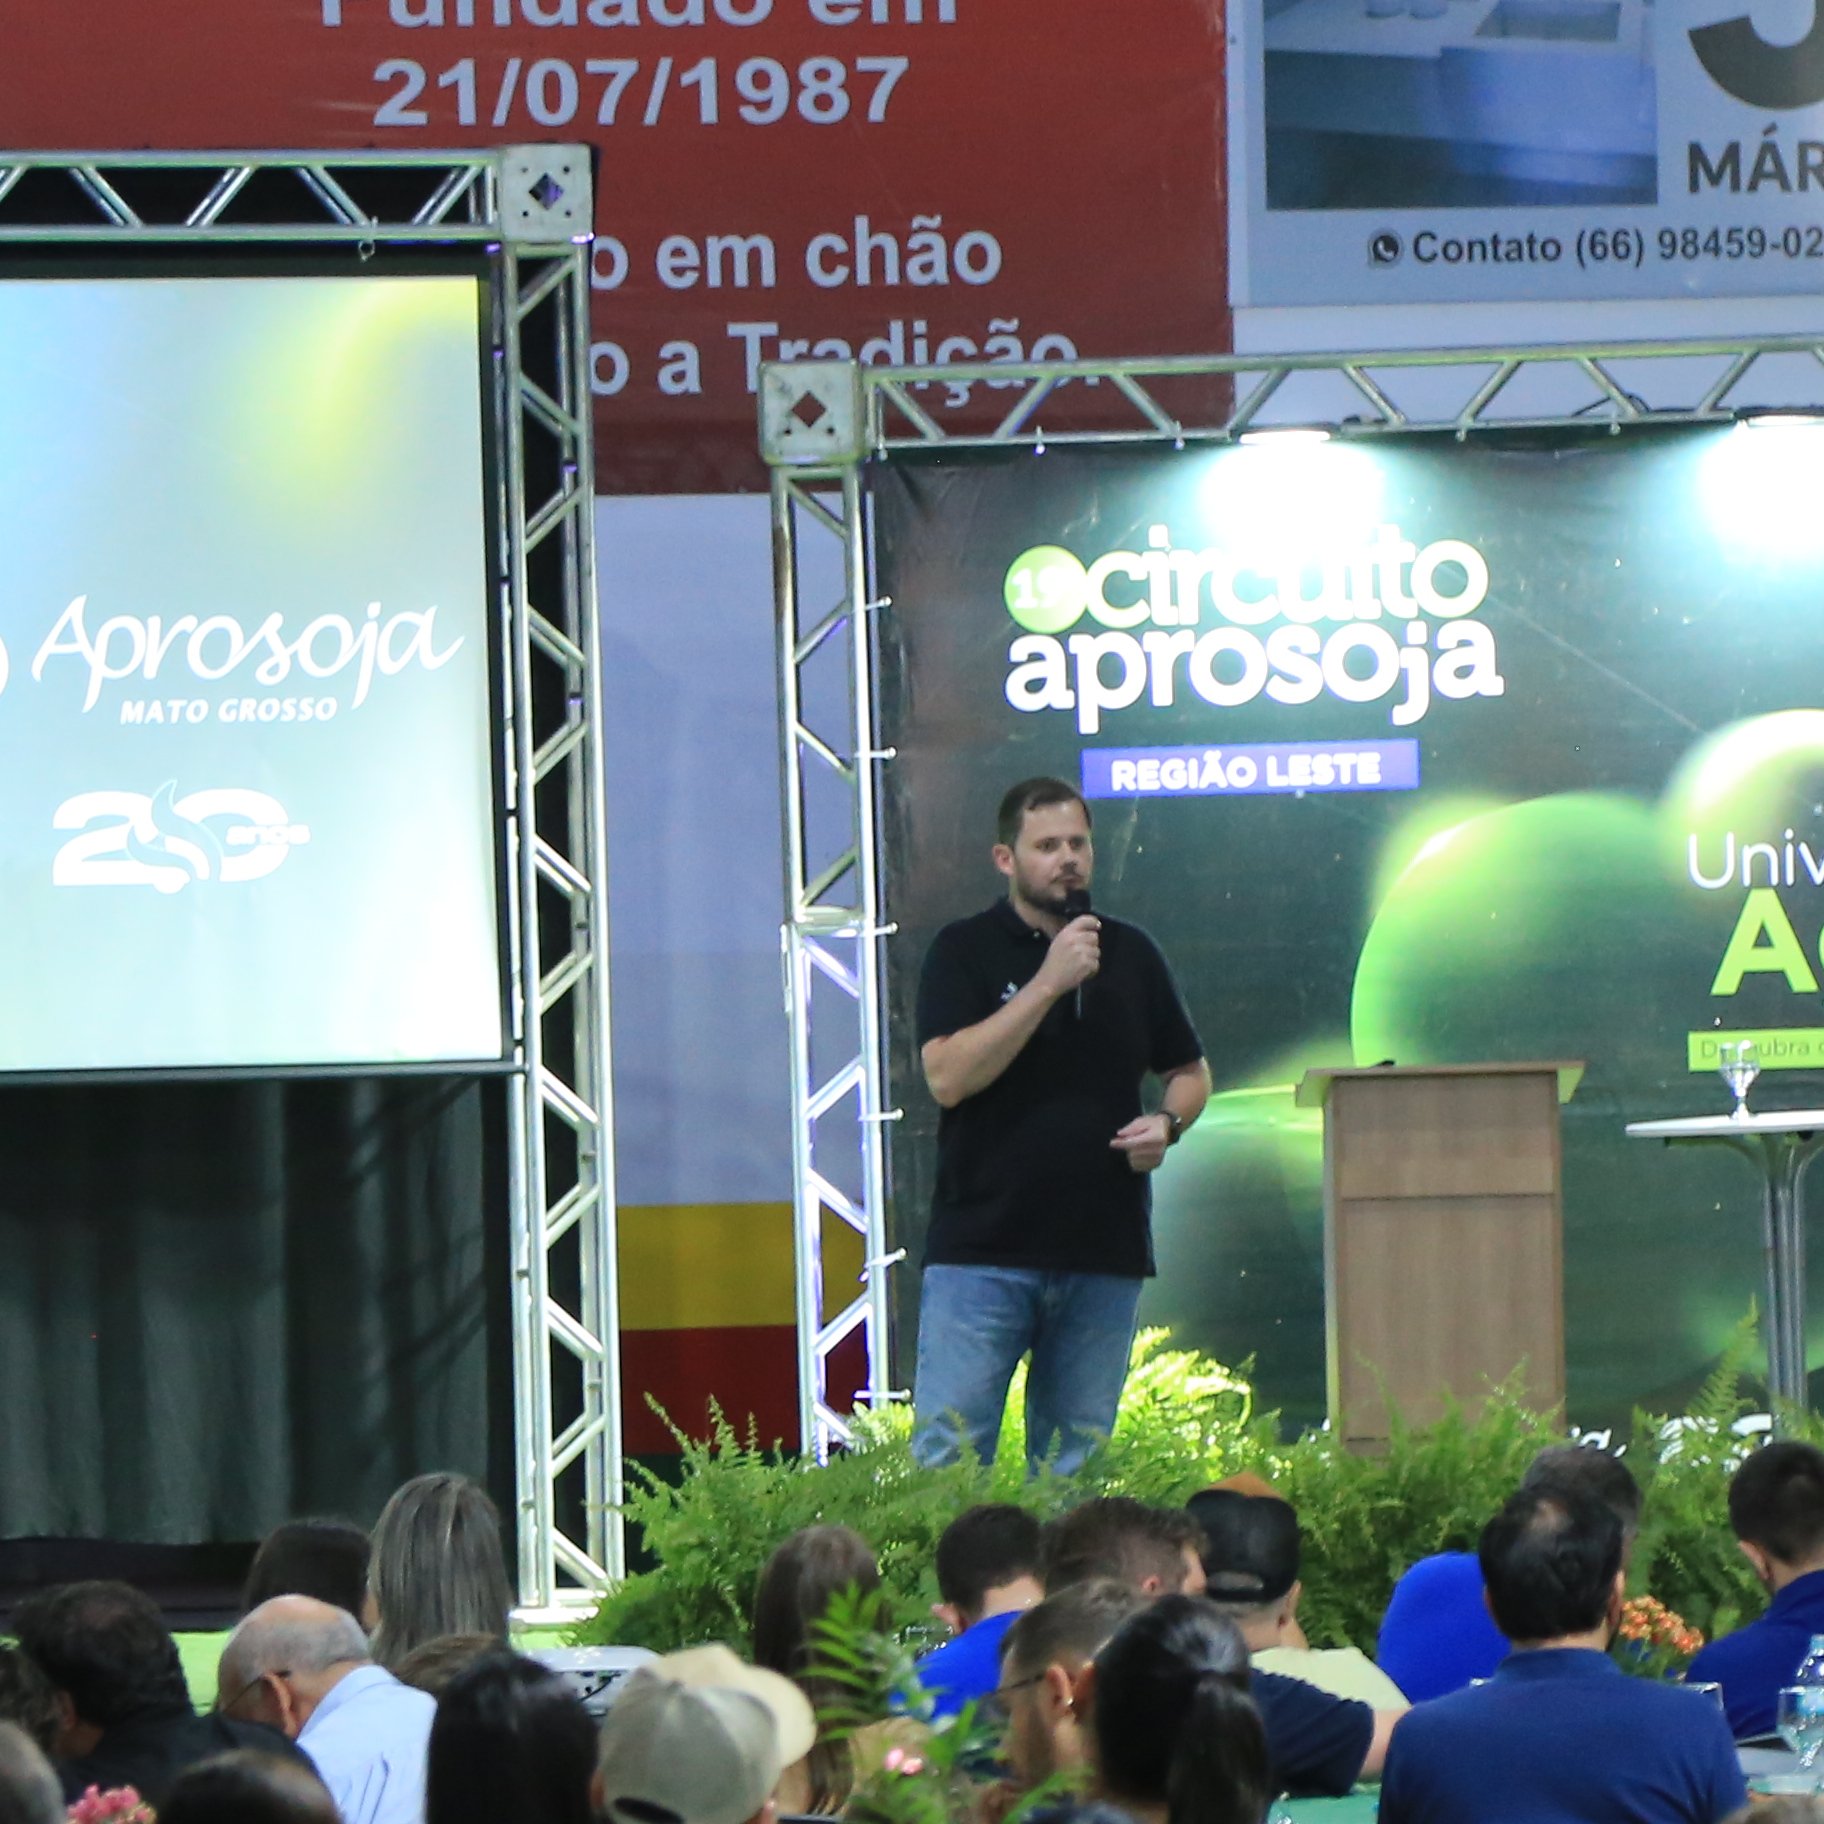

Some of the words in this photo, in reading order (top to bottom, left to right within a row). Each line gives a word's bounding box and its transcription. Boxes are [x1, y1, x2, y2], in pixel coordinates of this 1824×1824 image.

[371, 55, 910, 127] 21/07/1987
[655, 233, 777, 291] em
[805, 213, 1003, 288] chão
[1412, 229, 1563, 265] Contato
[1575, 228, 1645, 269] (66)
[657, 340, 702, 396] a
[1085, 525, 1489, 629] circuito
[31, 594, 464, 713] Aprosoja
[1004, 619, 1505, 734] aprosoja
[120, 698, 210, 725] MATO
[217, 696, 339, 724] GROSSO
[1111, 749, 1258, 792] REGIÃO
[1265, 751, 1382, 788] LESTE
[1700, 1038, 1810, 1060] Dubra
